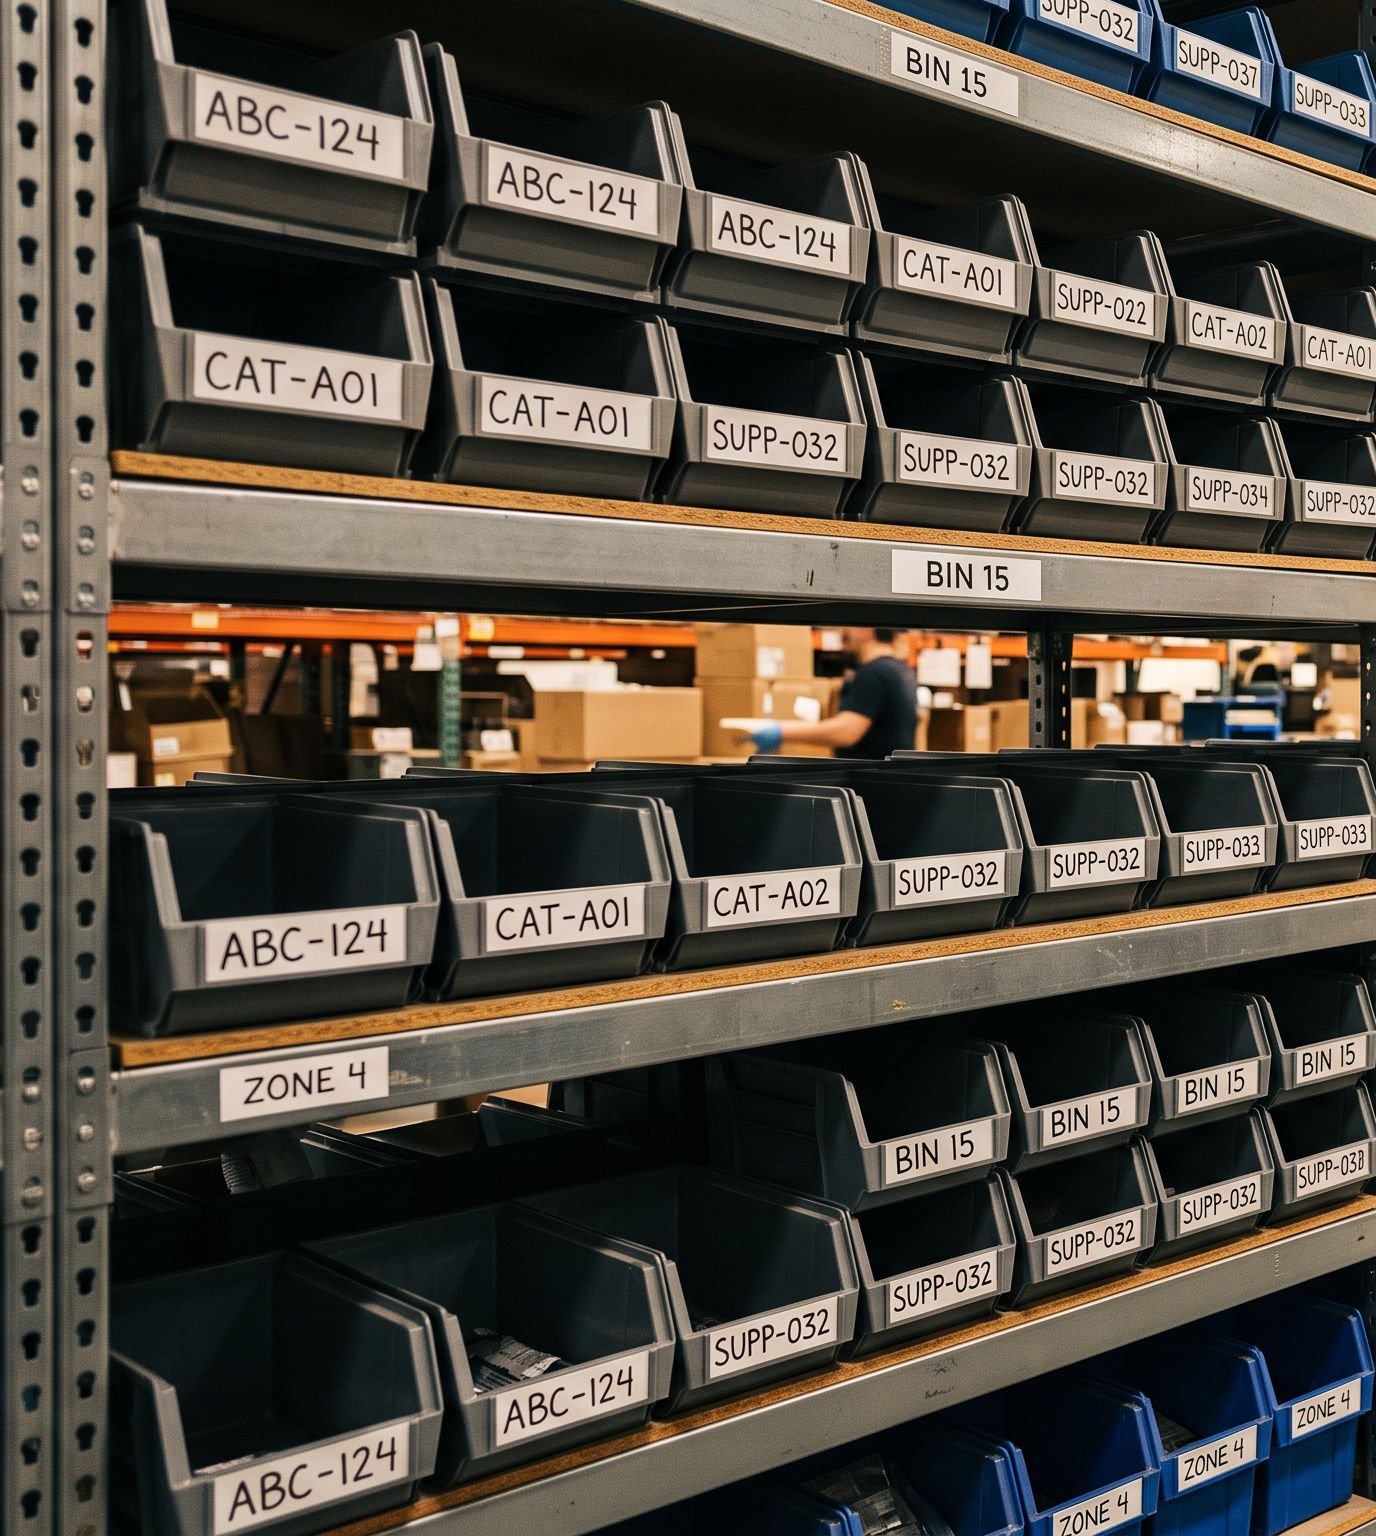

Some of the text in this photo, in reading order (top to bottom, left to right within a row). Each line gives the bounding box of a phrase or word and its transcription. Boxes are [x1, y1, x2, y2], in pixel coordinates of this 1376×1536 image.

[906, 46, 987, 98] BIN 15
[1178, 40, 1258, 89] SUPP-037
[204, 90, 380, 161] ABC-124
[1295, 82, 1366, 128] SUPP-033
[496, 161, 637, 221] ABC-124
[717, 210, 836, 263] ABC-124
[1057, 282, 1147, 326] SUPP-022
[713, 418, 839, 462] SUPP-032
[904, 442, 1010, 481] SUPP-032
[1058, 461, 1149, 496] SUPP-032
[1192, 475, 1268, 508] SUPP-034
[1307, 489, 1376, 516] SUPP-032
[926, 560, 1010, 592] BIN 15
[1300, 823, 1367, 851] SUPP-033
[898, 860, 999, 896] SUPP-032
[1052, 847, 1140, 879] SUPP-032
[220, 918, 388, 971] ABC-124
[1302, 1041, 1356, 1078] BIN 15
[243, 1060, 366, 1105] ZONE 4
[1185, 1067, 1245, 1106] BIN 15
[1051, 1095, 1120, 1138] BIN 15
[895, 1129, 975, 1175] BIN 15
[1182, 1182, 1258, 1225] SUPP-032
[1050, 1219, 1136, 1266] SUPP-032
[893, 1260, 992, 1313] SUPP-032
[714, 1308, 830, 1367] SUPP-032
[502, 1365, 634, 1435] ABC-124
[1296, 1389, 1351, 1430] ZONE 4
[228, 1436, 397, 1522] ABC-124
[1184, 1437, 1244, 1482] ZONE 4
[1059, 1491, 1129, 1536] ZONE 4
